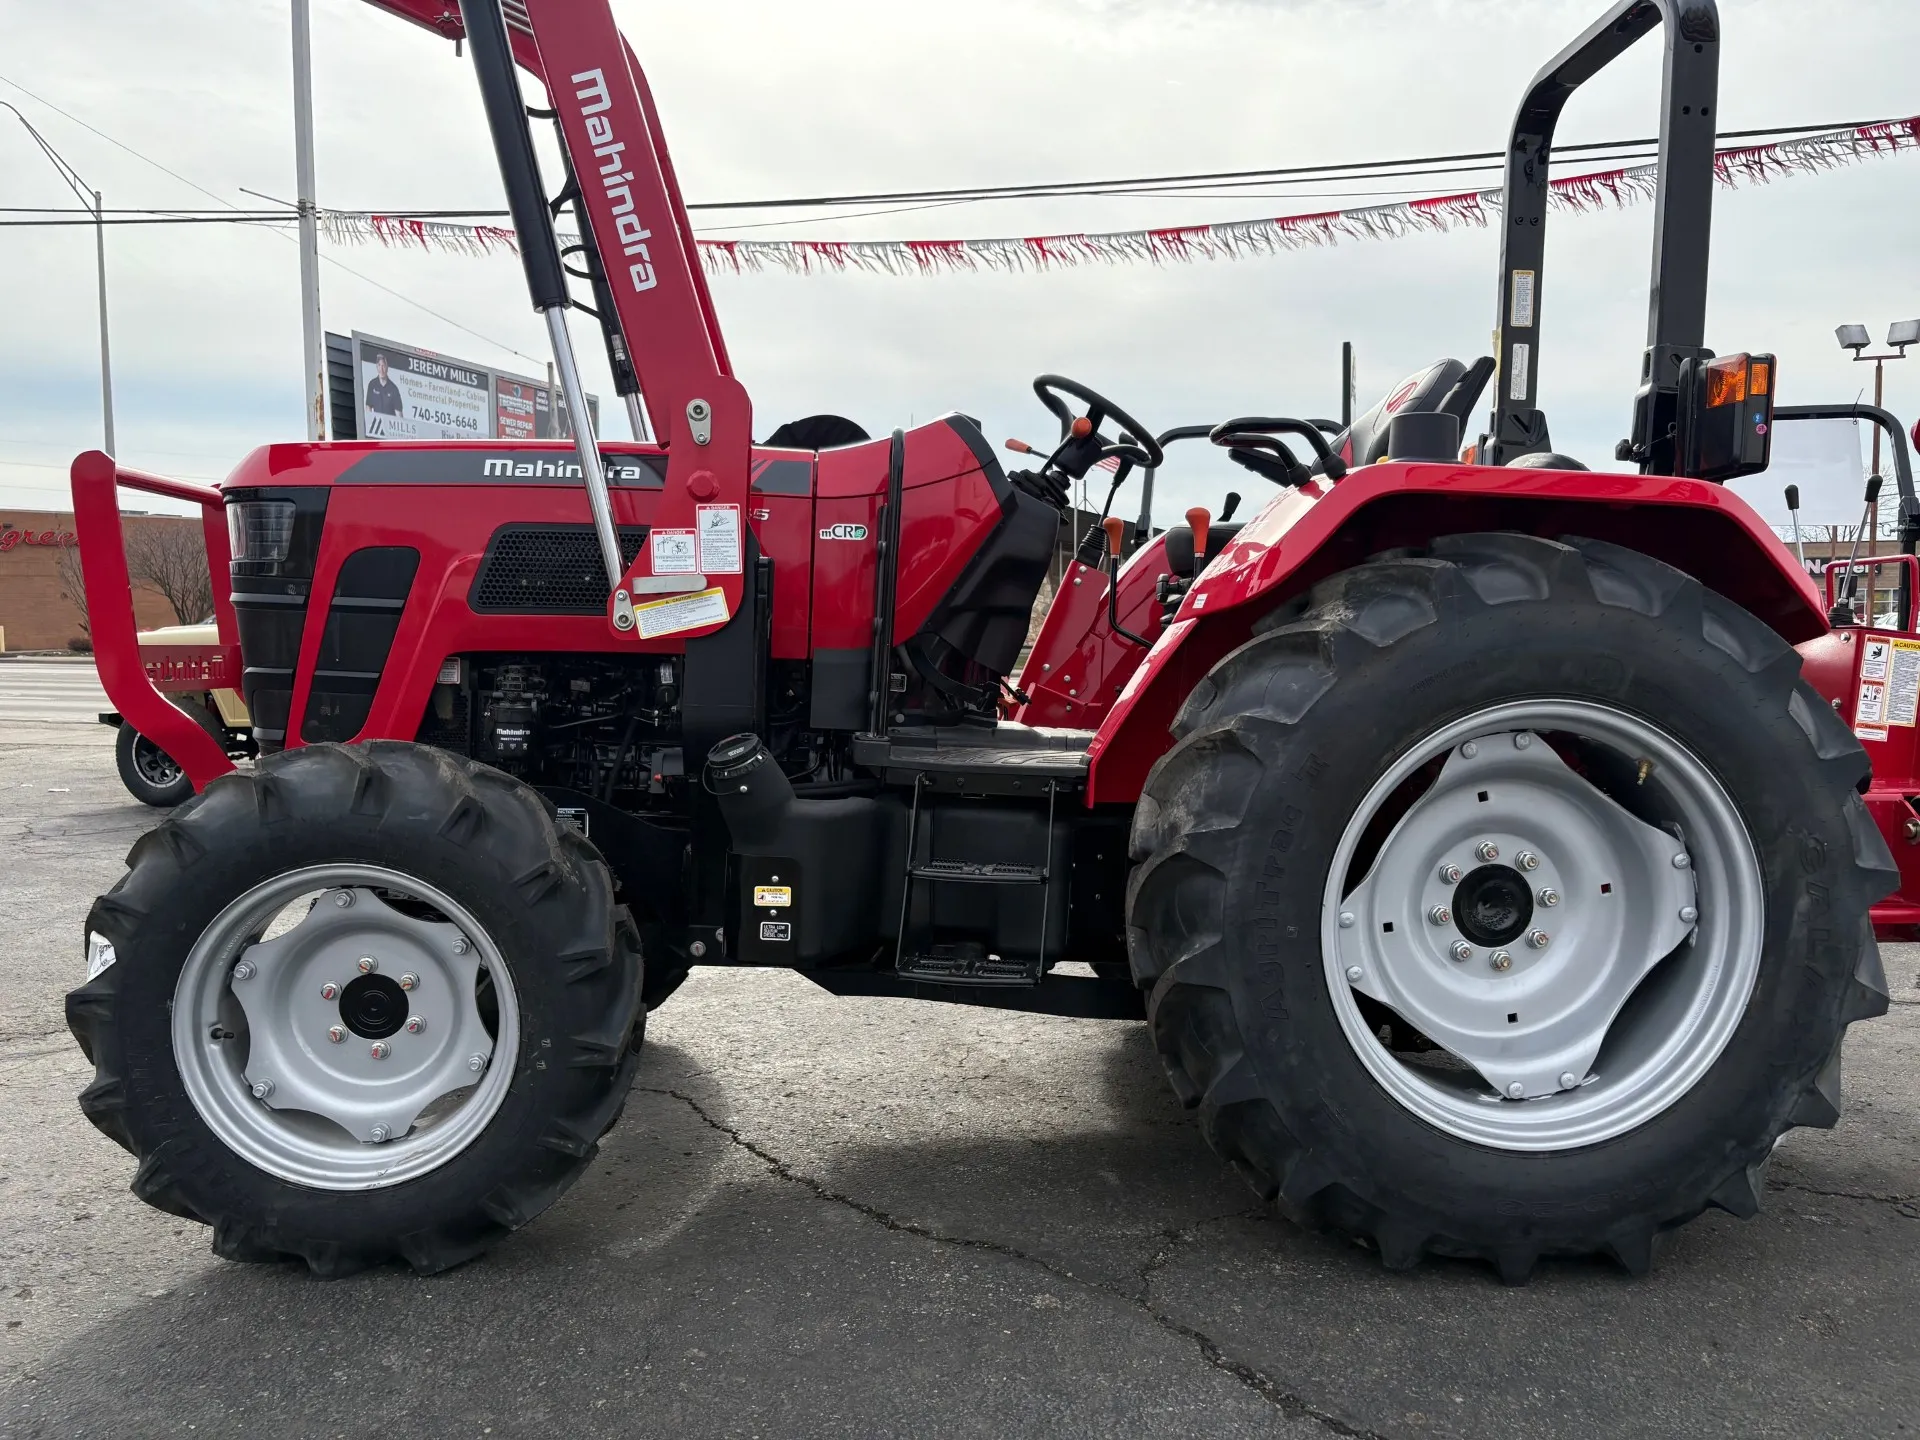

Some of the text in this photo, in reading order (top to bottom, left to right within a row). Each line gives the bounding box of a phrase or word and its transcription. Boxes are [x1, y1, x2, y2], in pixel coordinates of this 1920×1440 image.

[408, 358, 478, 385] JEREMY MILLS
[400, 374, 423, 388] Homes
[466, 391, 486, 403] Cabins
[407, 388, 480, 411] Commercial Properties
[388, 420, 417, 434] MILLS
[412, 405, 478, 431] 740-503-6648
[483, 459, 641, 479] Mahinra
